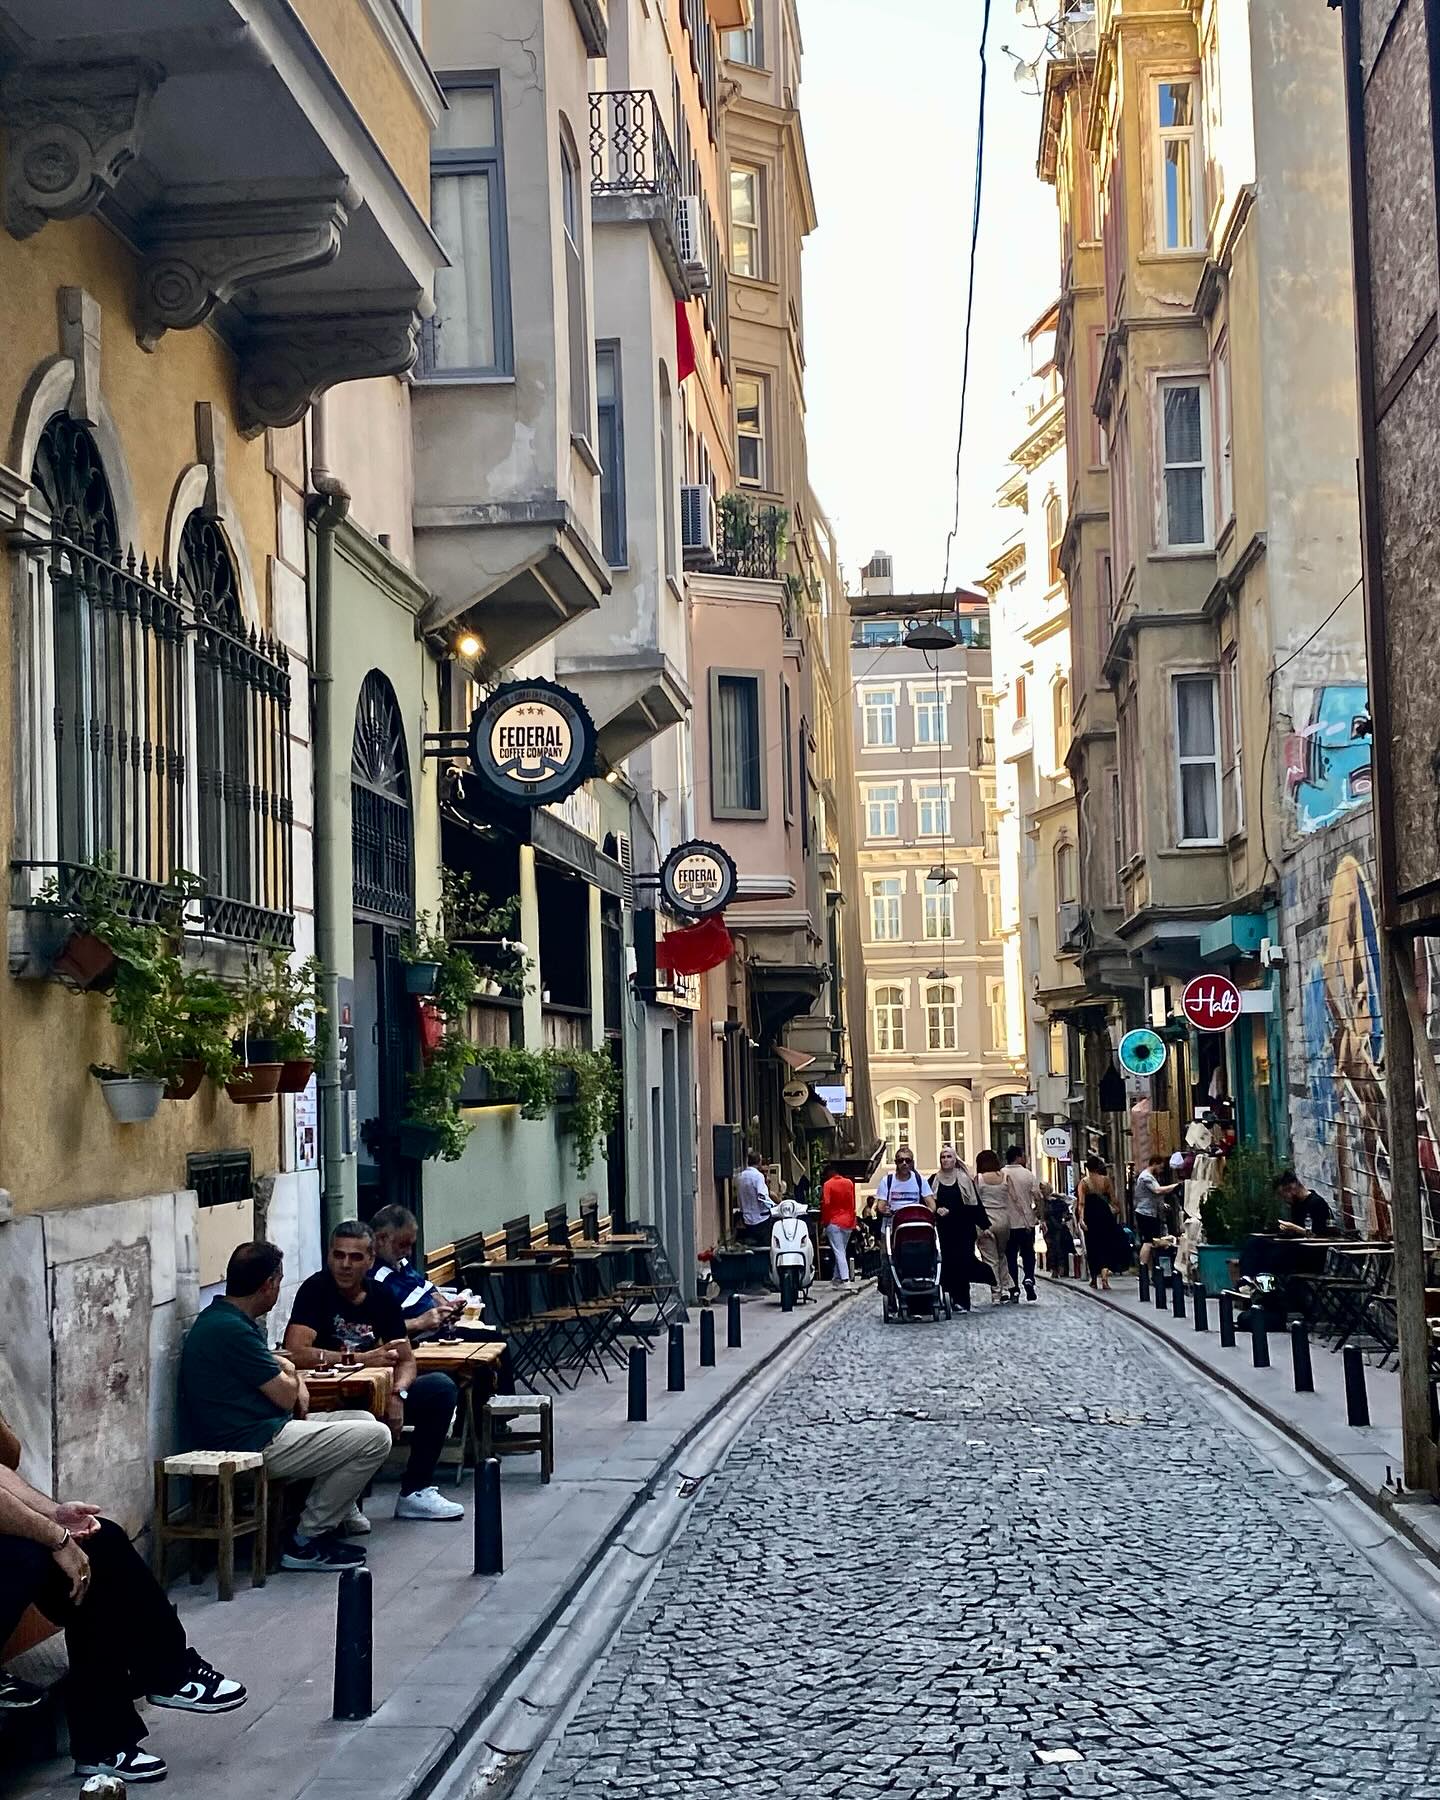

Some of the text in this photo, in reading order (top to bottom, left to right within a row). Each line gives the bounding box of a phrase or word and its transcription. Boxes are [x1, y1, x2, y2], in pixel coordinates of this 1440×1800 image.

[499, 726, 563, 747] FEDERAL
[499, 747, 563, 758] COFFEE COMPANY
[678, 868, 718, 882] FEDERAL
[1185, 985, 1237, 1018] Halt
